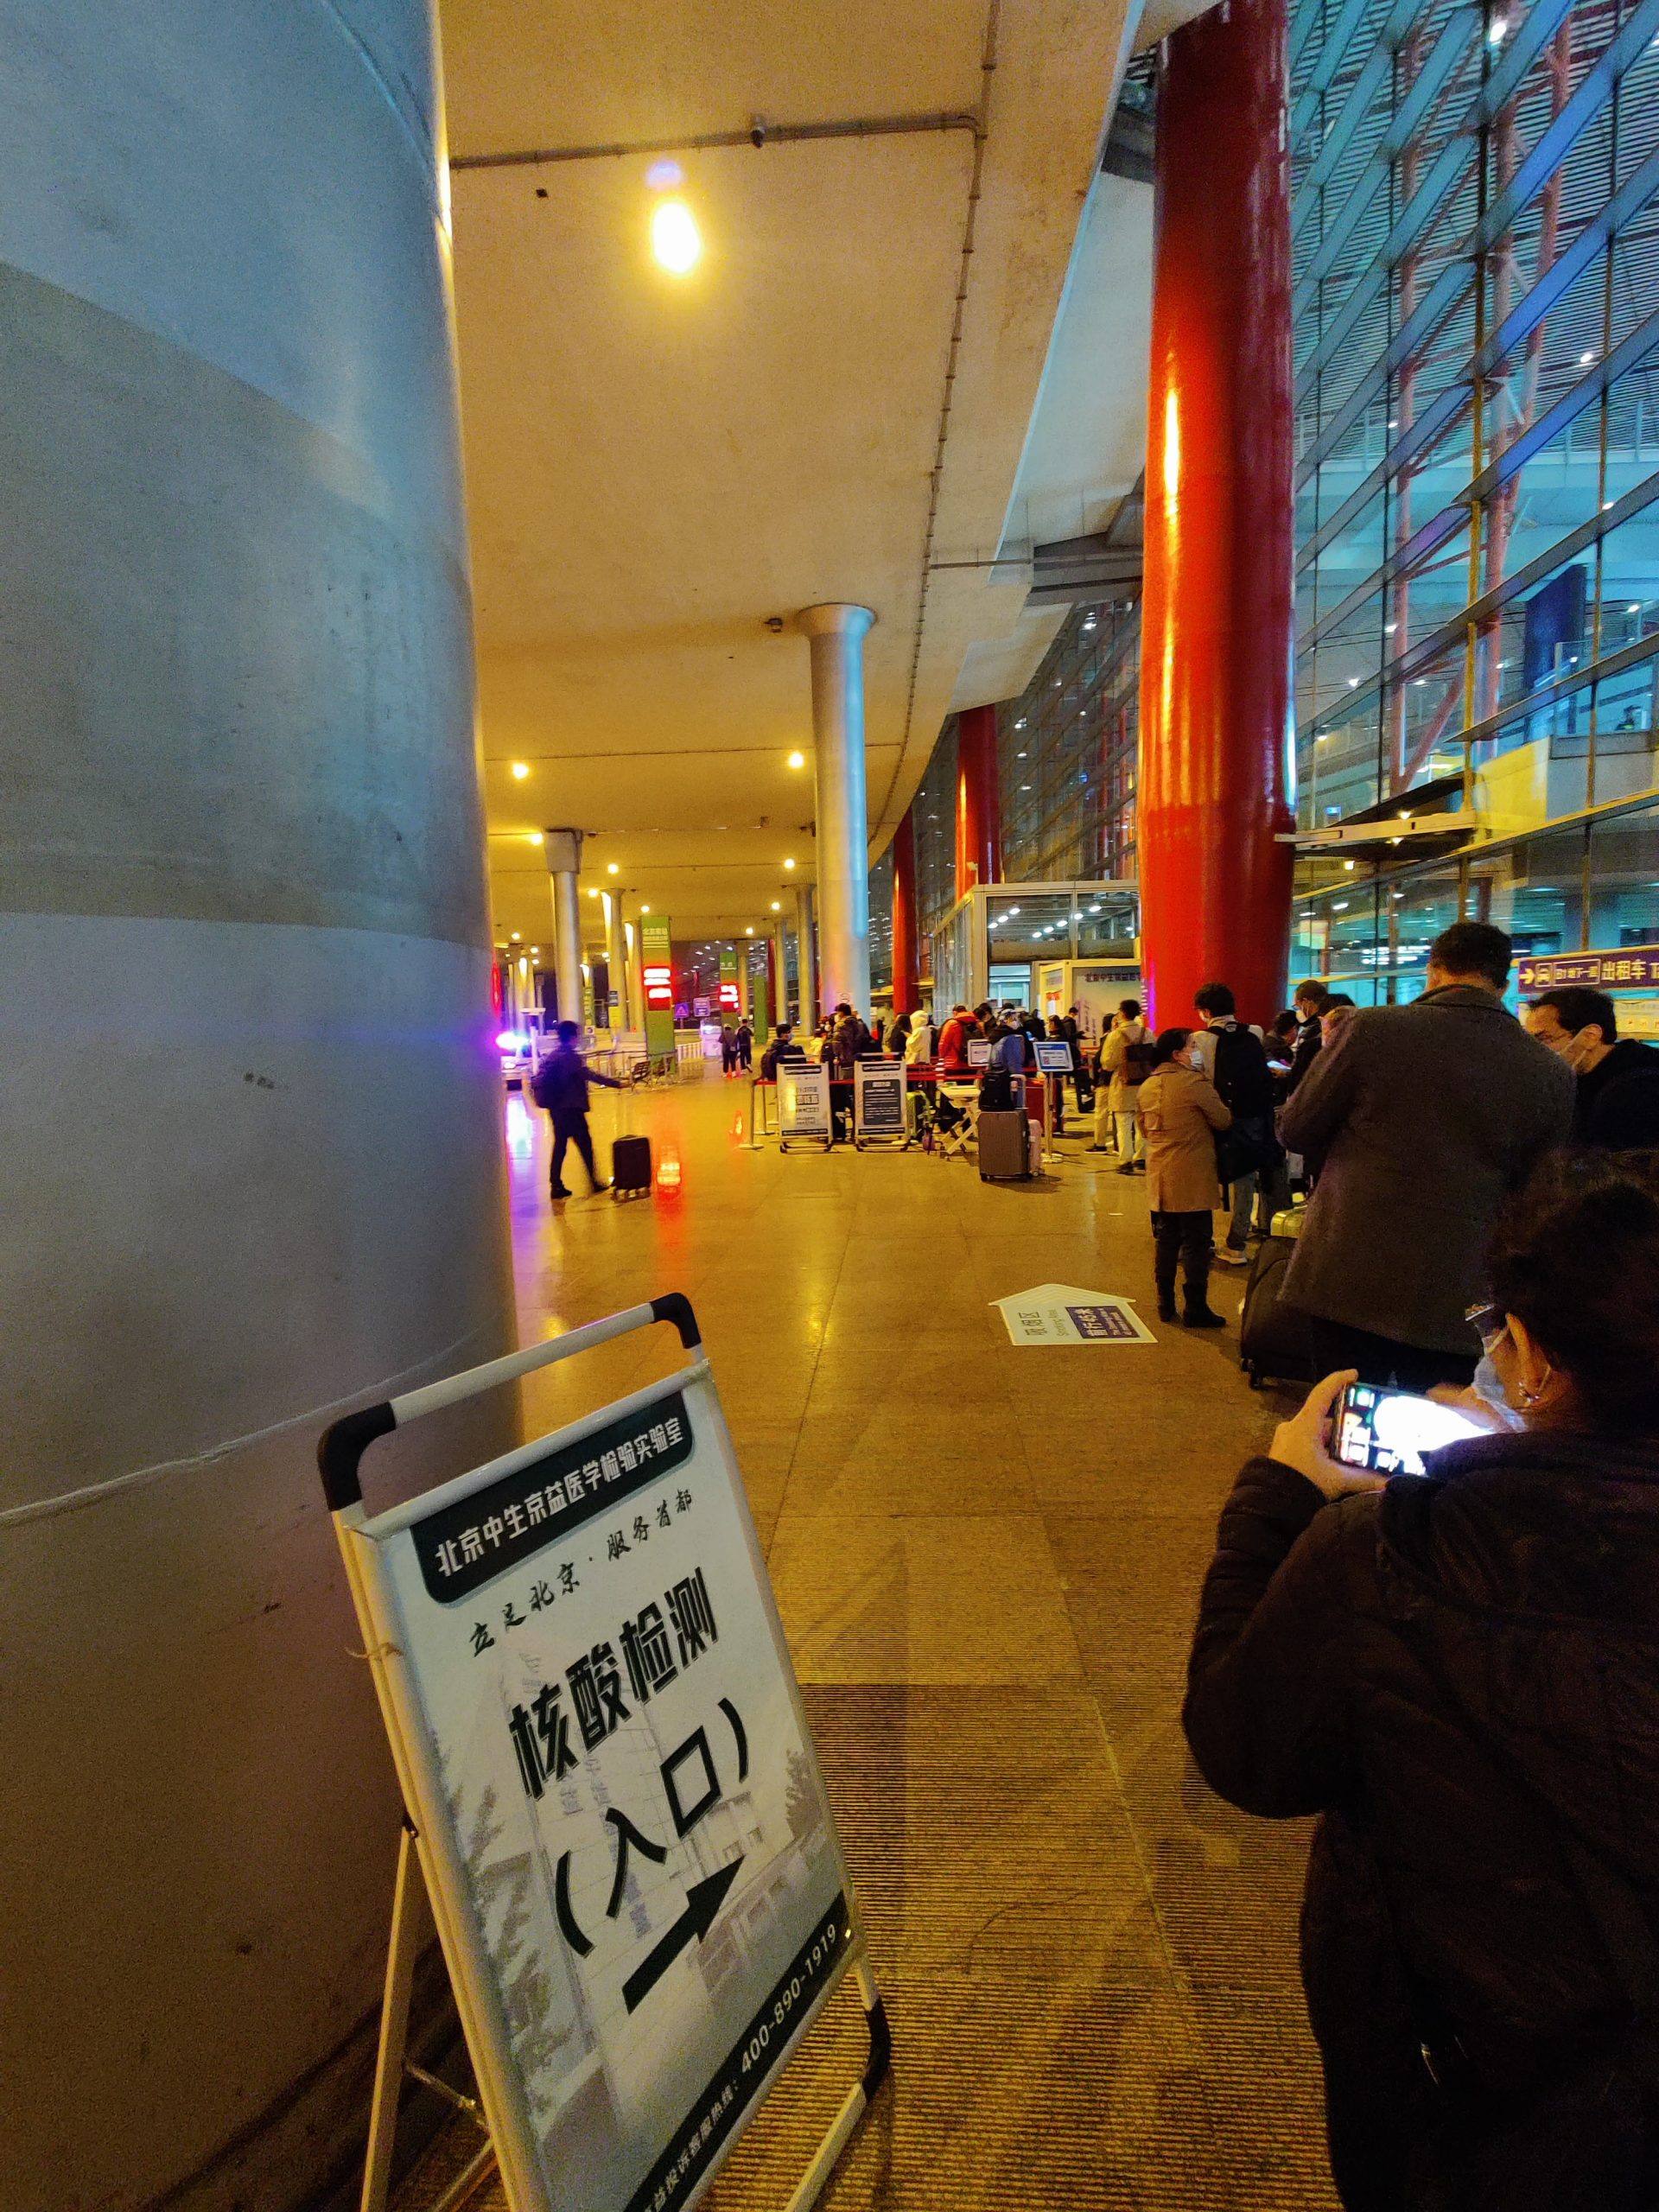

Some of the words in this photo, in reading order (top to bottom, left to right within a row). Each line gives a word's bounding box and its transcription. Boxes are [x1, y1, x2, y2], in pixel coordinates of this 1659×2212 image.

[1601, 959, 1646, 981] 出租车
[435, 1416, 684, 1577] 北京中生京益医学检验实验室
[509, 1567, 719, 1802] 核酸检测
[742, 1923, 836, 2073] 400-890-1919
